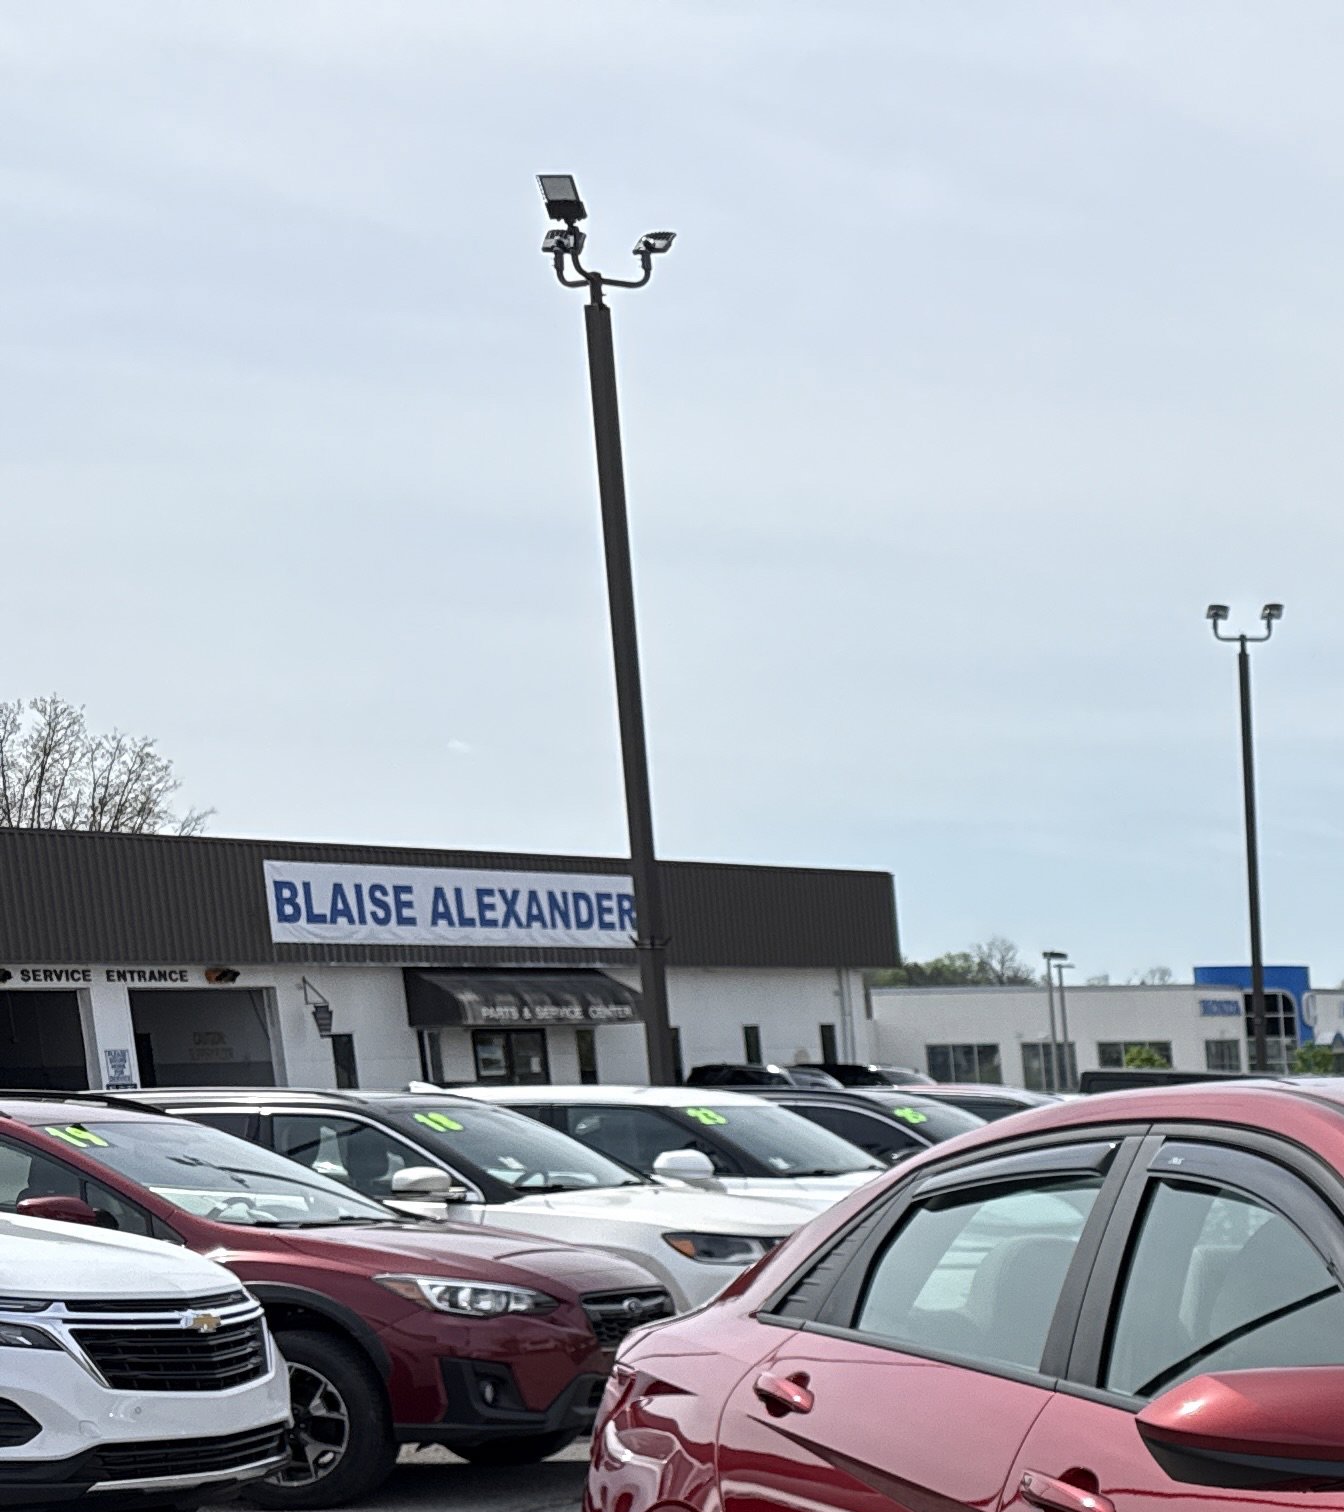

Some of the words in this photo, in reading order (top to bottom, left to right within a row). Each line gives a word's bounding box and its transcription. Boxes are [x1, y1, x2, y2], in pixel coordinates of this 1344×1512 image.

[273, 880, 418, 925] BLAISE
[430, 886, 636, 931] ALEXANDER
[20, 969, 92, 982] SERVICE
[106, 969, 189, 983] ENTRANCE
